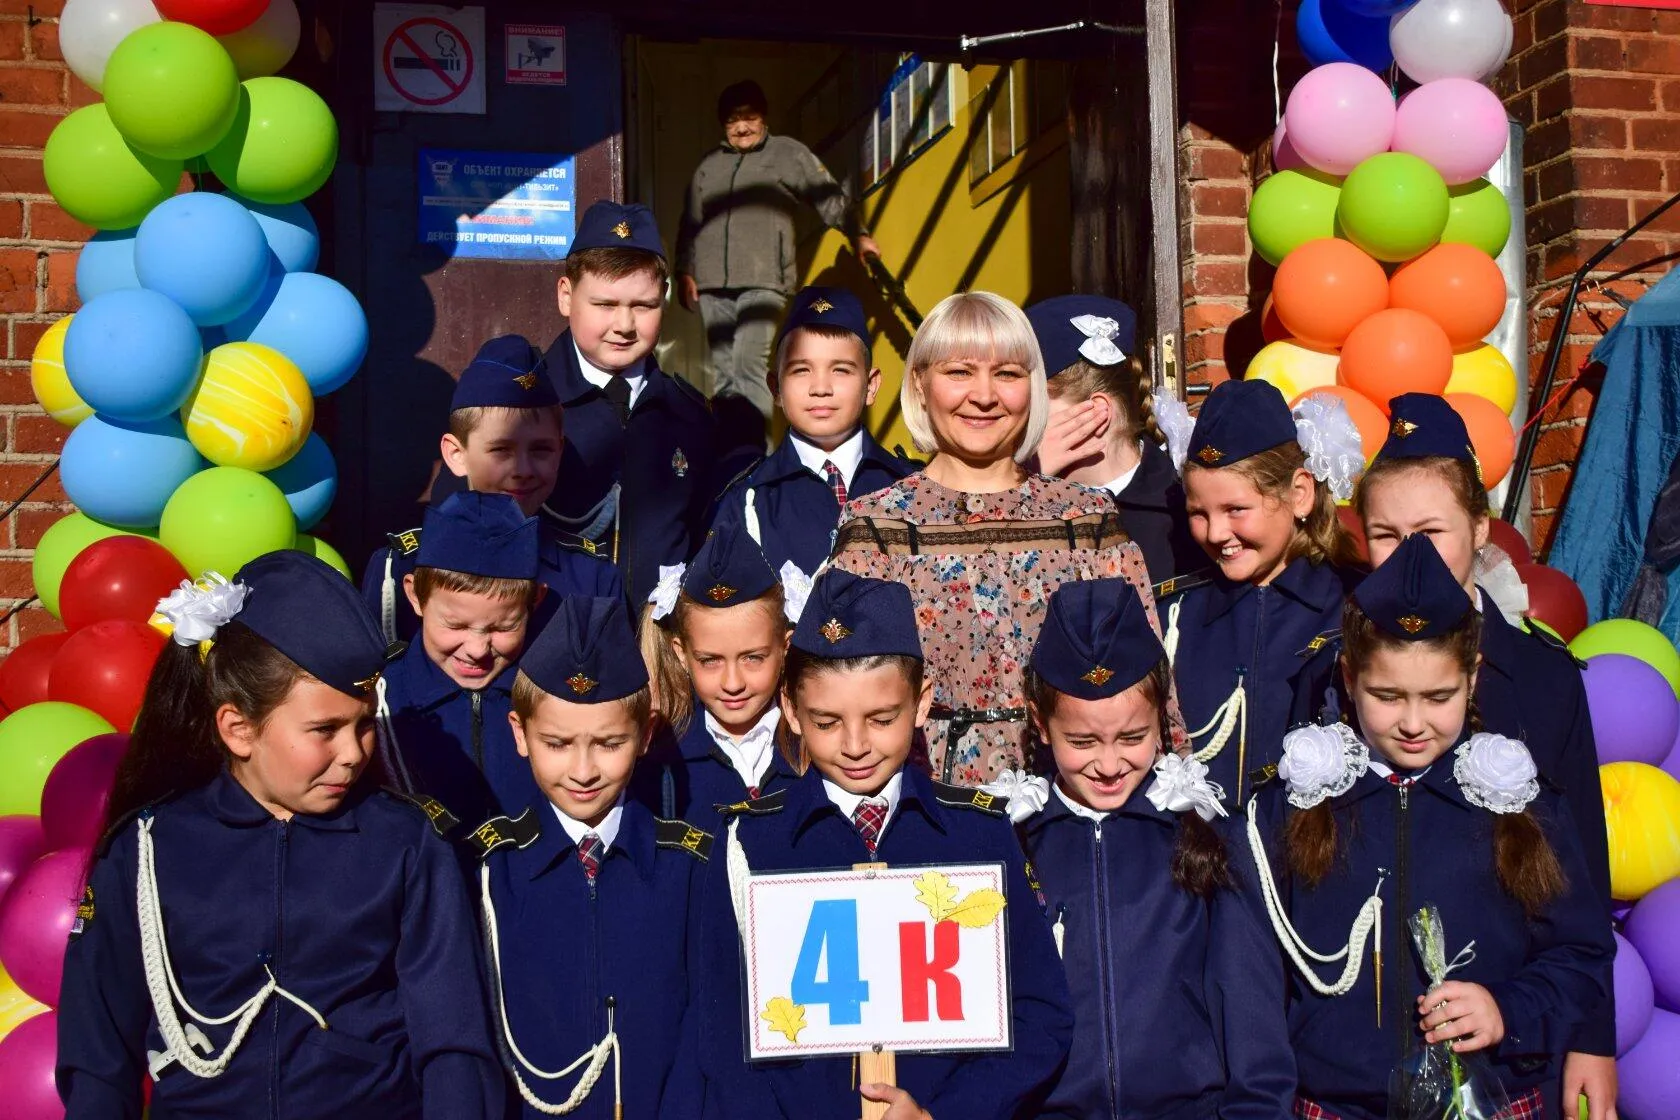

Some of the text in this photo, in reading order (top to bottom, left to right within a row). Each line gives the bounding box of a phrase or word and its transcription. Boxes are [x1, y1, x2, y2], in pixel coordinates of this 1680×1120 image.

[504, 167, 567, 179] ОХРАНЯЕТСЯ
[426, 231, 567, 245] ДЕЙСТВУЕТ ПРОПУСКНОЙ РЕЖИМ
[791, 899, 869, 1025] 4
